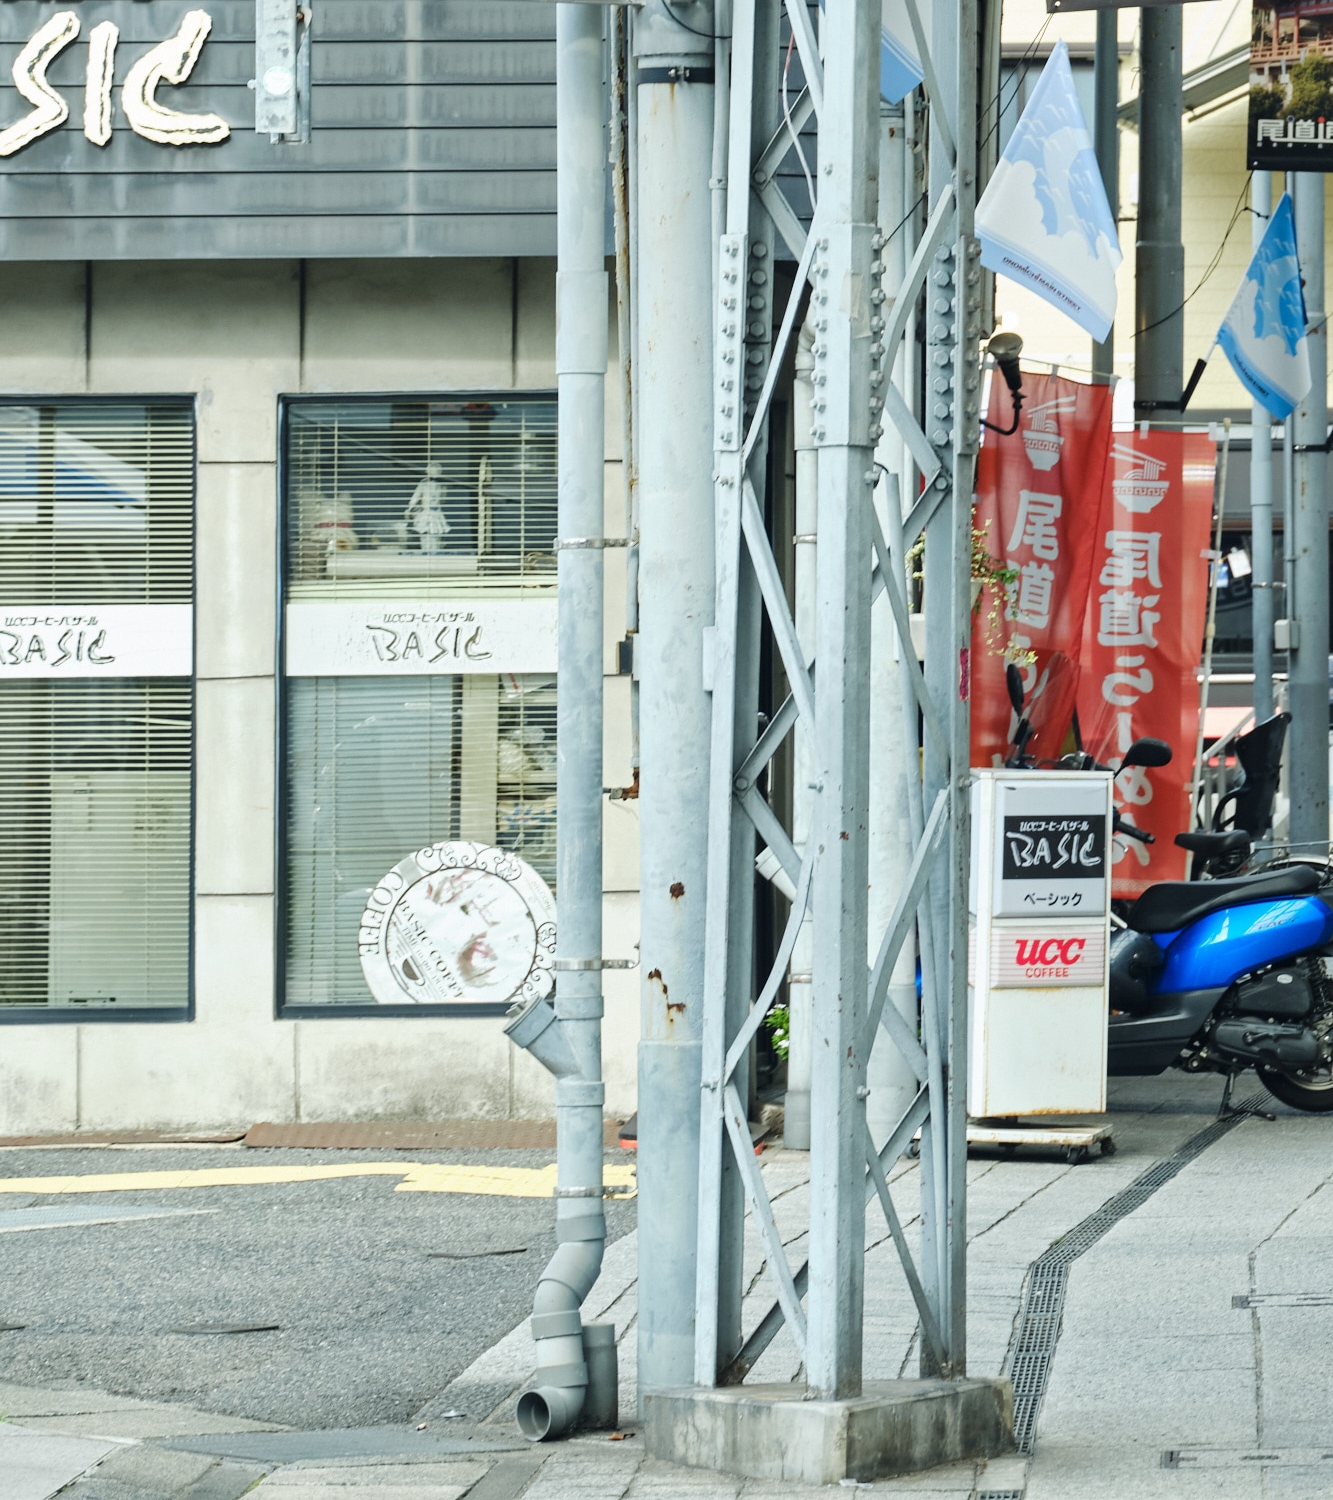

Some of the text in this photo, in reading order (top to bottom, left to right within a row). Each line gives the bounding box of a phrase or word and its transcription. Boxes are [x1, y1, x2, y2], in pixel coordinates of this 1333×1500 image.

[366, 625, 492, 663] BASIC
[1005, 830, 1102, 869] BASIC
[358, 870, 404, 958] COFFEE
[1024, 892, 1083, 908] ベーシック
[1025, 967, 1069, 978] COFFEE
